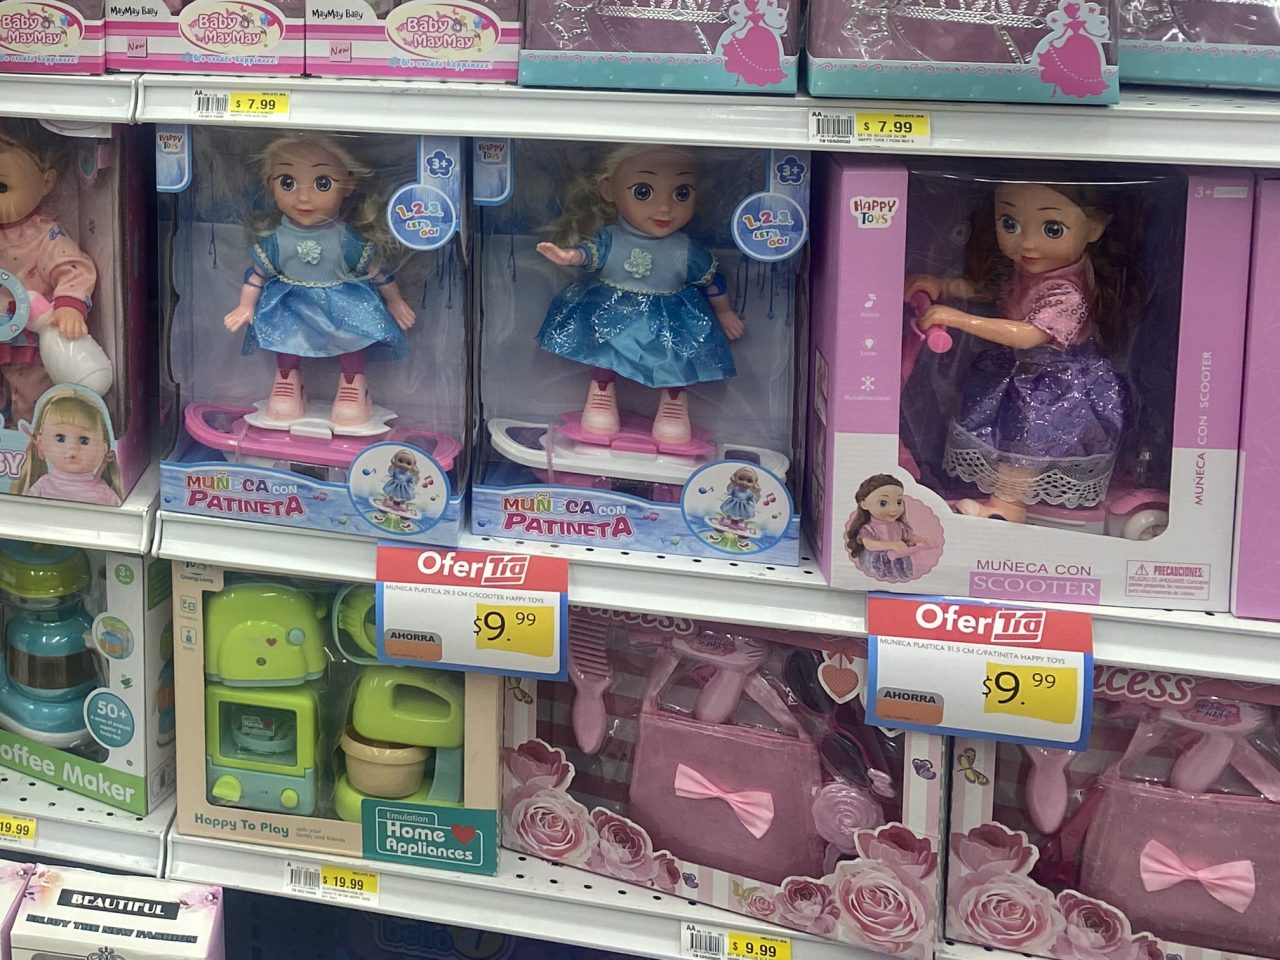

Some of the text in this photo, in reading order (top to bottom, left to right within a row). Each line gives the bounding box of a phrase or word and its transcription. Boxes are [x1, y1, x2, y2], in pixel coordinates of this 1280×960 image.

[406, 16, 449, 34] Baby
[412, 32, 474, 49] MayMay
[247, 98, 276, 110] 7.99
[854, 198, 897, 214] HAPPY
[861, 212, 889, 225] TOYS
[1194, 351, 1213, 506] MUÑECA CON SCOOTER
[598, 504, 626, 516] CON
[503, 511, 633, 538] PATINETA
[976, 559, 1092, 577] MUÑECA CON
[973, 575, 1096, 597] SCOOTER
[469, 591, 504, 601] C/SCOOTER
[505, 594, 526, 603] HAPPY
[527, 596, 544, 604] TOYS
[390, 631, 436, 644] AHORRA
[947, 644, 960, 653] 31.5
[962, 646, 974, 654] CM
[976, 646, 1019, 660] C/PATINETA
[1020, 652, 1044, 662] HAPPY
[1046, 656, 1065, 665] TOYS
[883, 689, 937, 704] AHORRA
[96, 700, 128, 720] 50+
[62, 761, 135, 805] Maker
[194, 813, 237, 831] Happy
[240, 818, 257, 832] To
[261, 821, 289, 838] Play
[386, 811, 430, 824] Emulation
[0, 821, 30, 836] 19.99
[386, 820, 446, 843] Home
[385, 838, 474, 861] Appliances
[745, 941, 777, 958] 9.99
